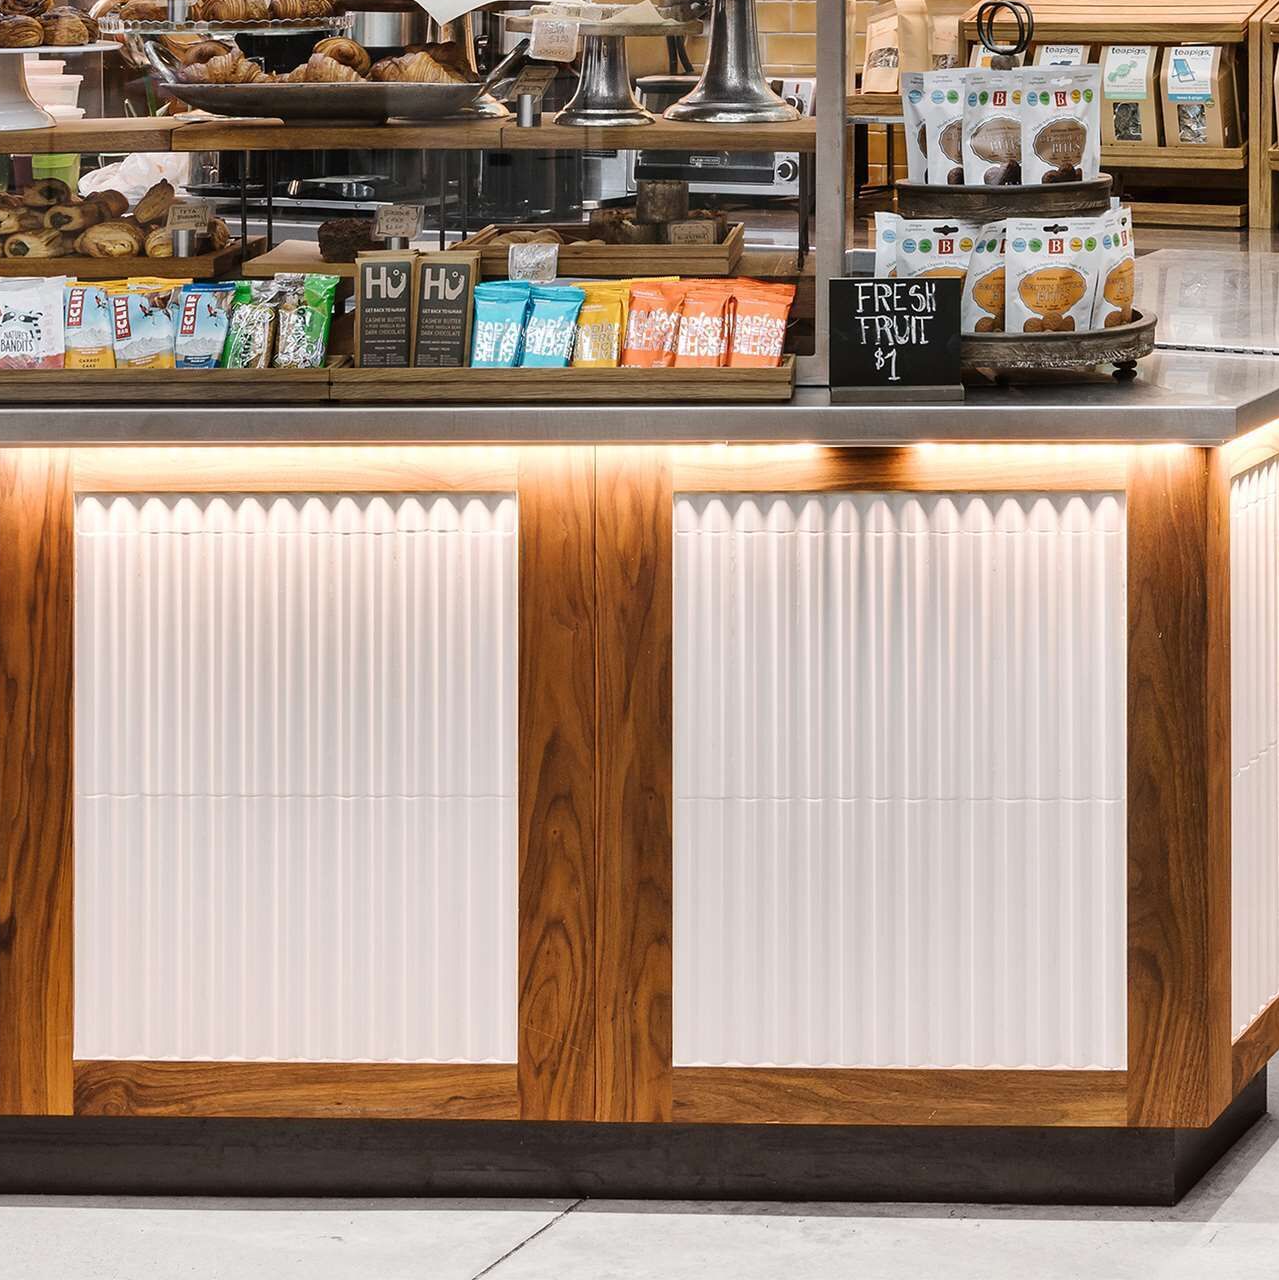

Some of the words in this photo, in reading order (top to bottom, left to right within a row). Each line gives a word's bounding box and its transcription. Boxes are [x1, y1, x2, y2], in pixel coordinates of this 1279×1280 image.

[366, 267, 407, 299] Hu
[424, 268, 465, 300] Hu
[854, 281, 937, 312] FRESH
[70, 287, 84, 318] CLIF
[115, 297, 128, 328] CLIF
[184, 295, 198, 324] CLIF
[0, 339, 34, 352] BANDITS
[3, 329, 29, 340] NATURE'S
[854, 315, 934, 346] FRUIT
[874, 347, 901, 381] $1
